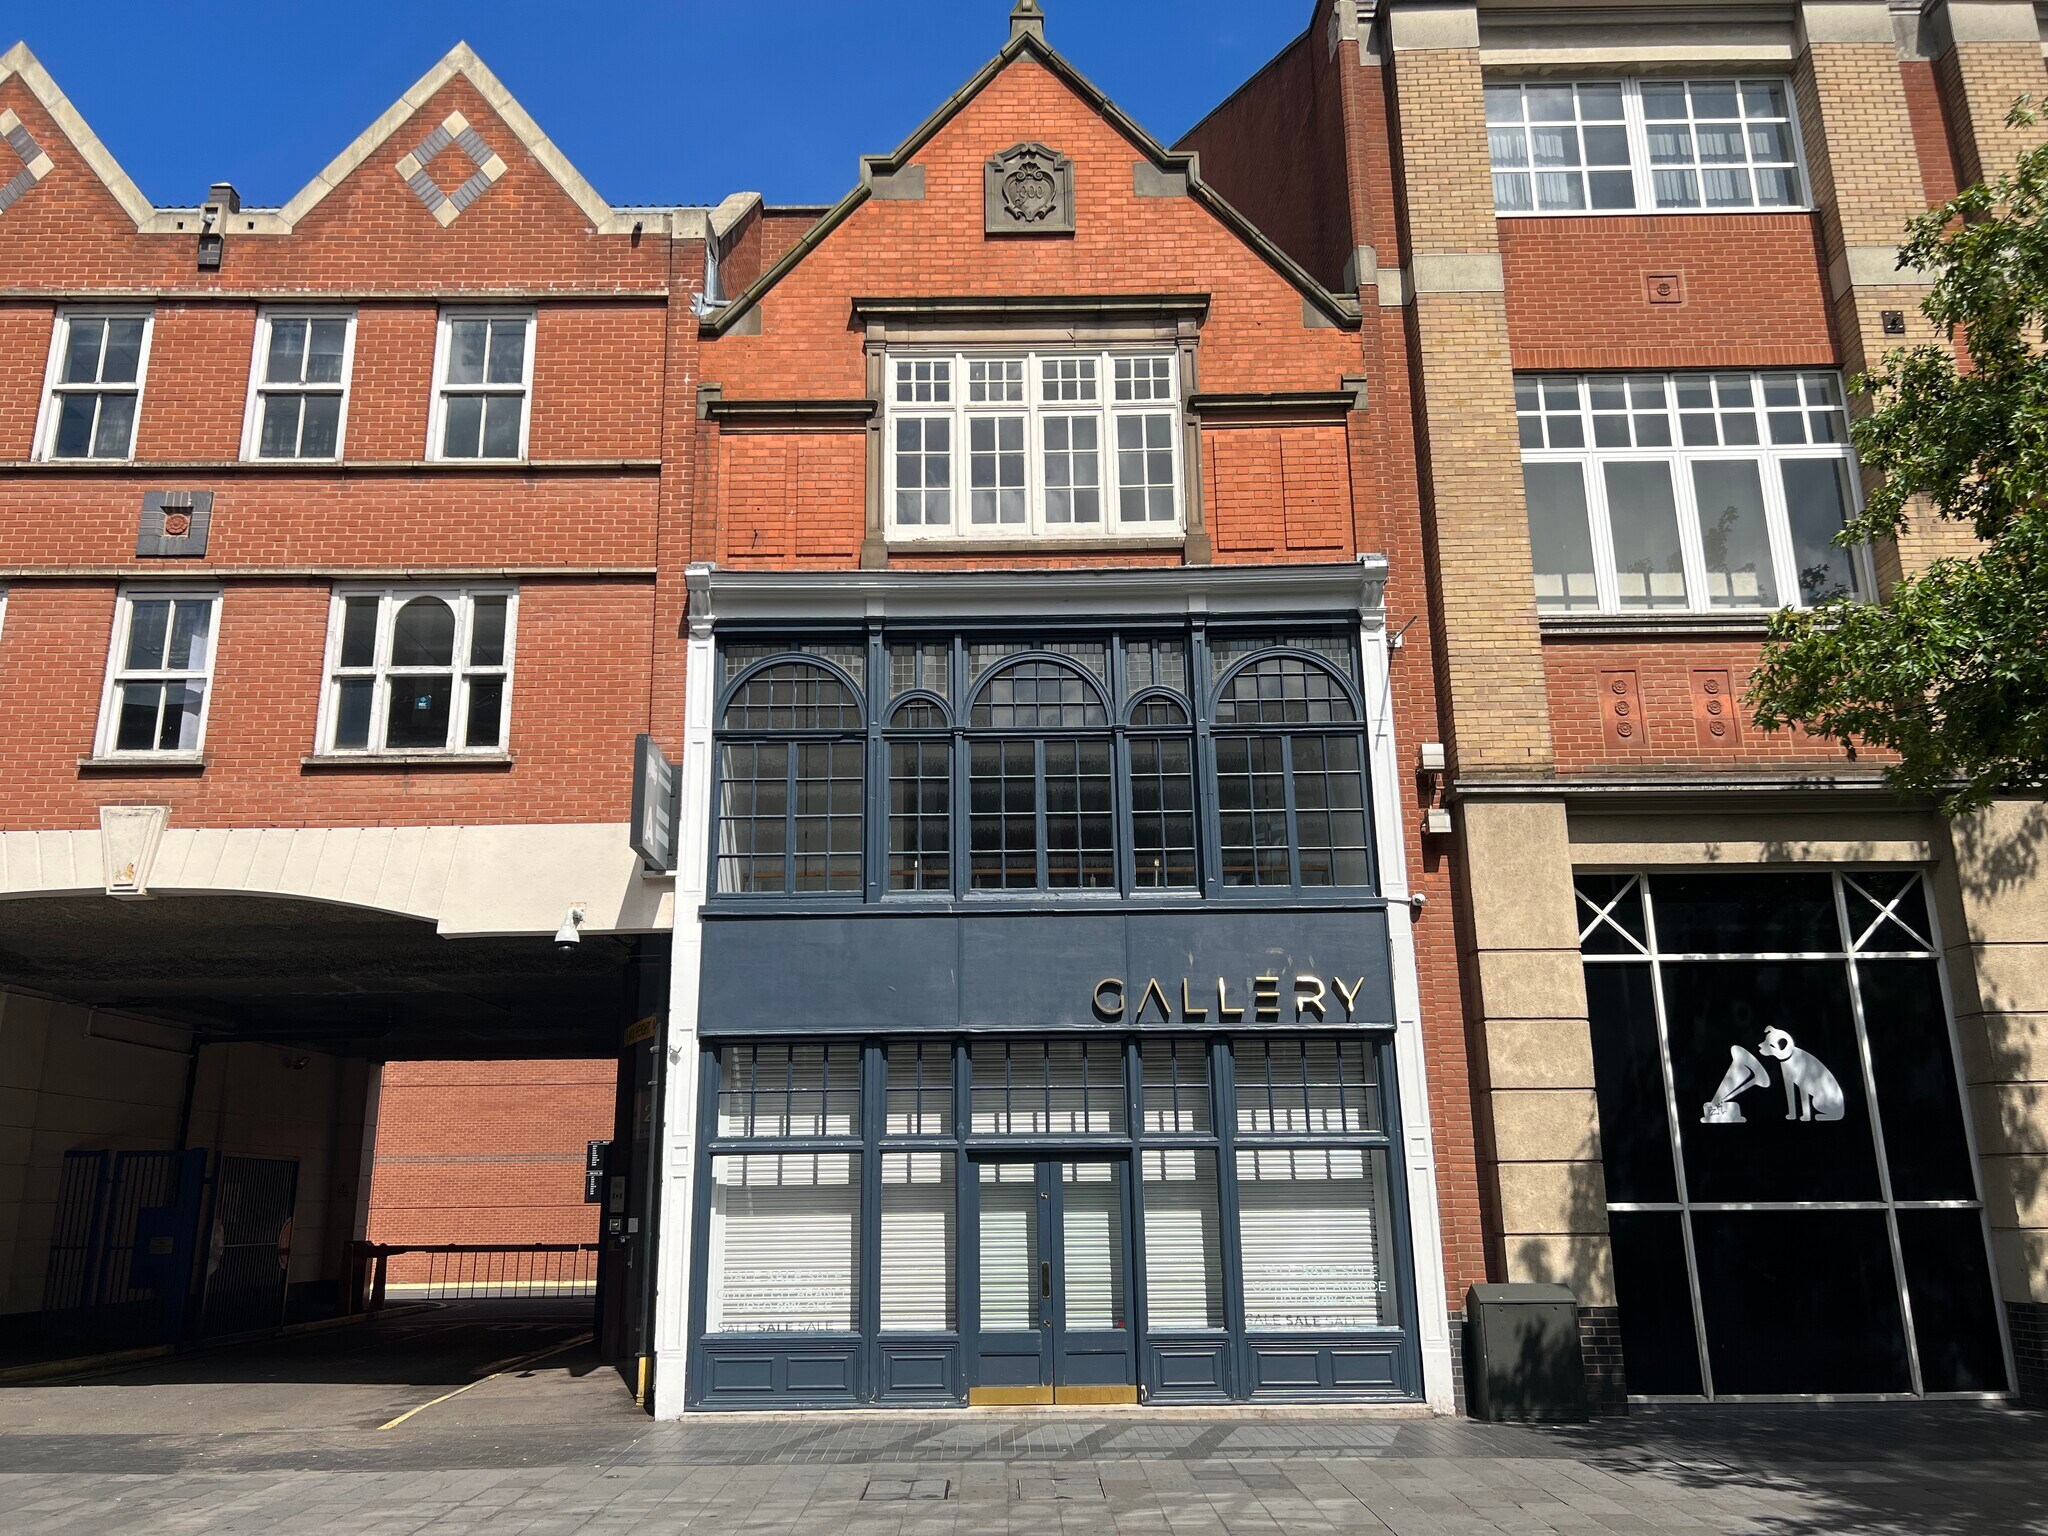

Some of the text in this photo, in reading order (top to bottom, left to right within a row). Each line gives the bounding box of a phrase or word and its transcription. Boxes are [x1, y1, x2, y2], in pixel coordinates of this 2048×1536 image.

[1094, 977, 1365, 1014] GALLERY
[1286, 1315, 1320, 1326] SALE
[758, 1323, 793, 1332] SALE
